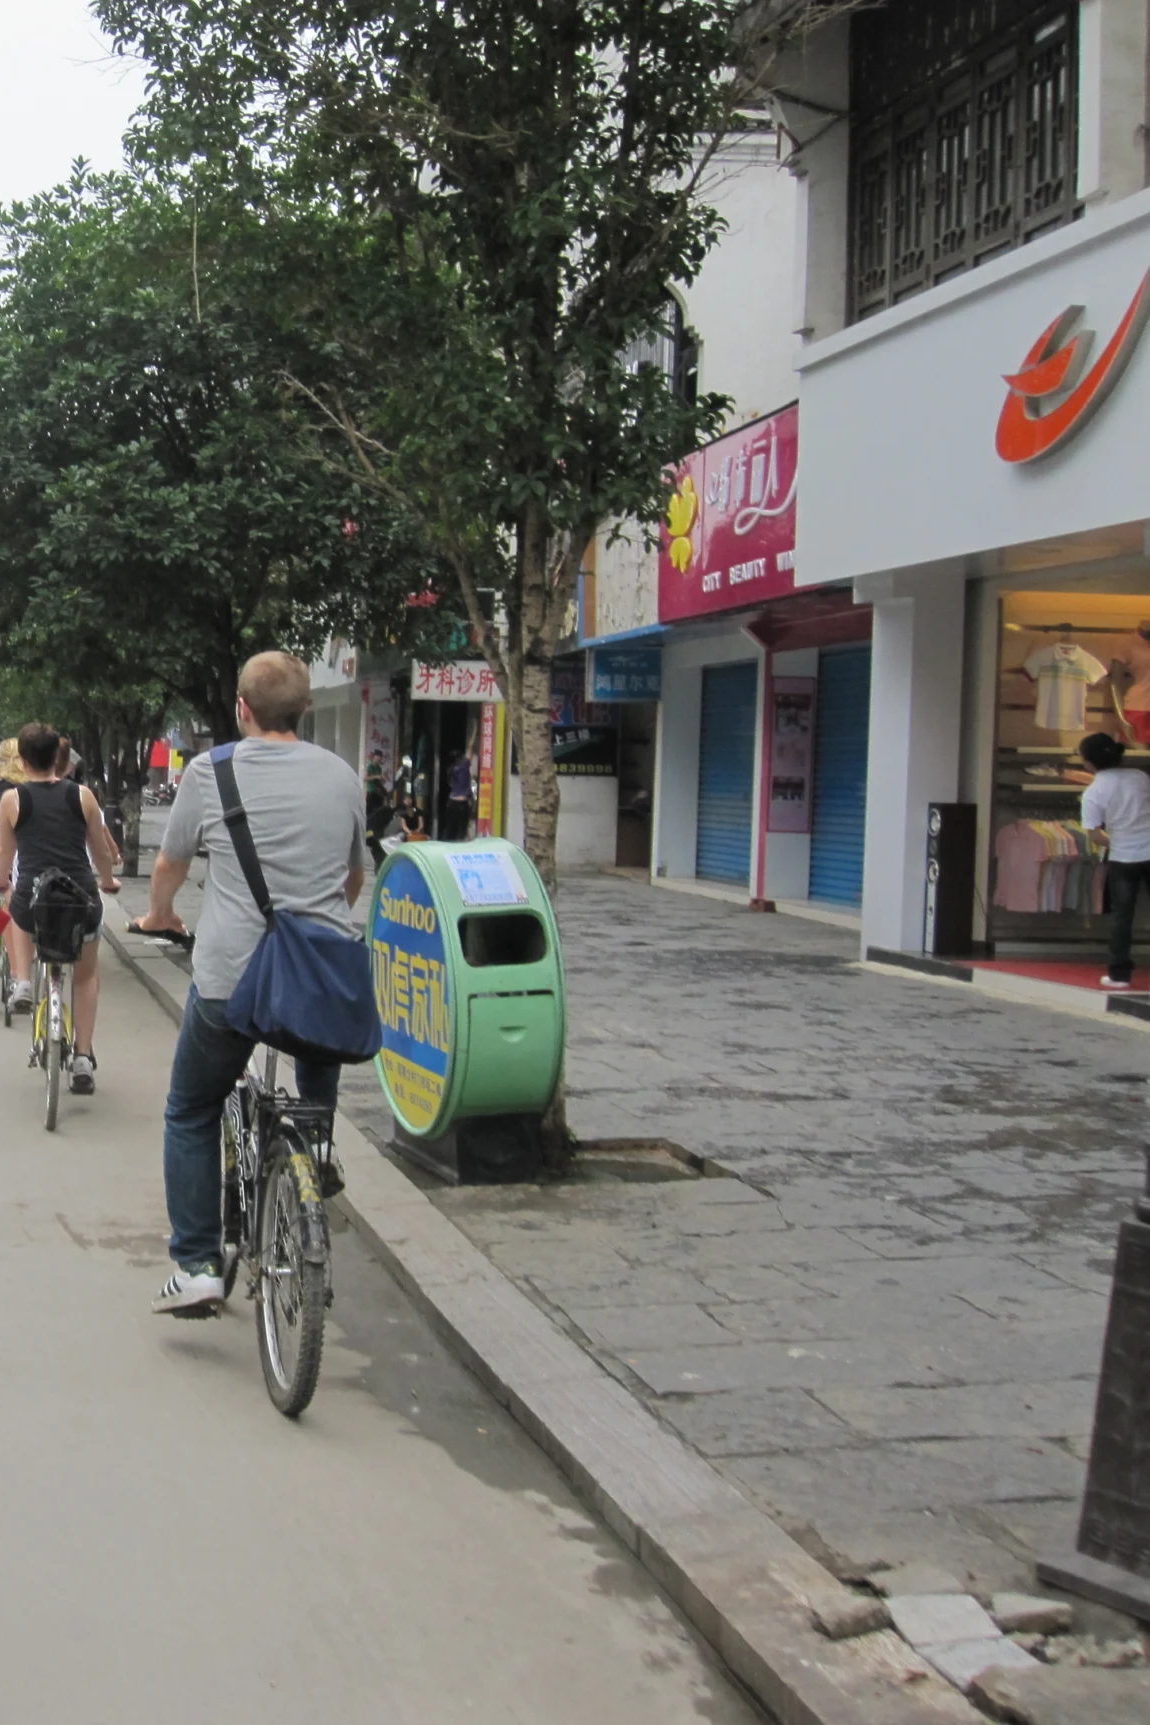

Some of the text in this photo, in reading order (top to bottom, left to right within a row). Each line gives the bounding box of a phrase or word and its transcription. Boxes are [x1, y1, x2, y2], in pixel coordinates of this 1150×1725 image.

[703, 571, 721, 592] CITY
[730, 558, 766, 585] BEAUTY
[415, 664, 498, 697] 牙科诊所
[380, 887, 436, 934] Sunhoo
[372, 939, 449, 1054] 双虎家私
